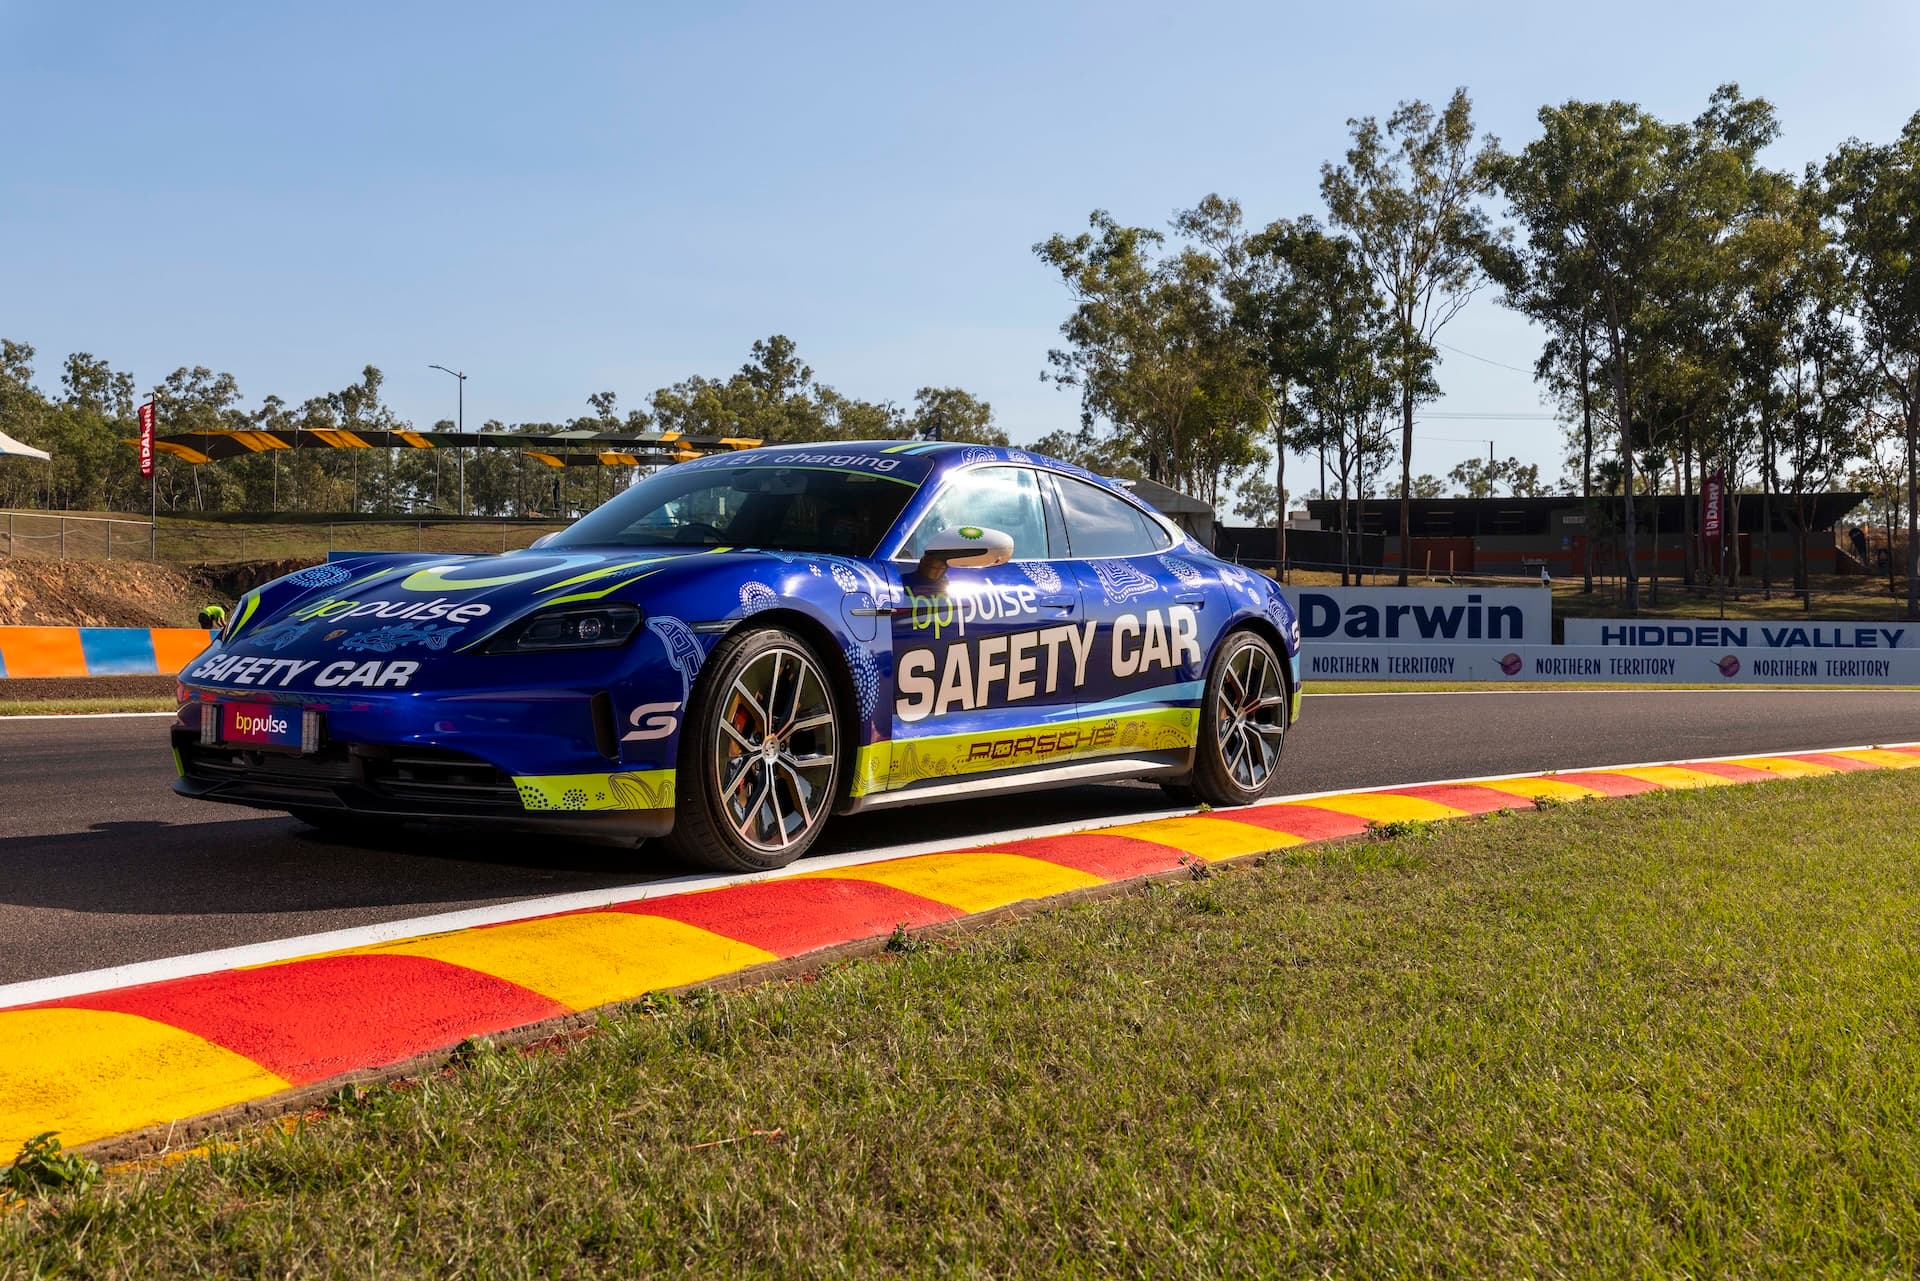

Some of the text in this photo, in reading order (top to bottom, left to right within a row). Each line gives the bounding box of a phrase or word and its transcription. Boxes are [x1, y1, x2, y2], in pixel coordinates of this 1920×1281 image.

[726, 454, 769, 465] EV
[774, 453, 901, 472] charging
[1299, 593, 1524, 640] Darwin
[1601, 625, 1905, 649] HIDDEN VALLEY
[191, 653, 420, 688] SAFETY CAR
[895, 604, 1202, 723] SAFETY CAR
[1312, 656, 1455, 675] NORTHERN TERRITORY
[1536, 657, 1675, 677] NORTHERN TERRITORY
[1753, 659, 1890, 678] NORTHERN TERRITORY
[967, 724, 1117, 762] PORSCHE
